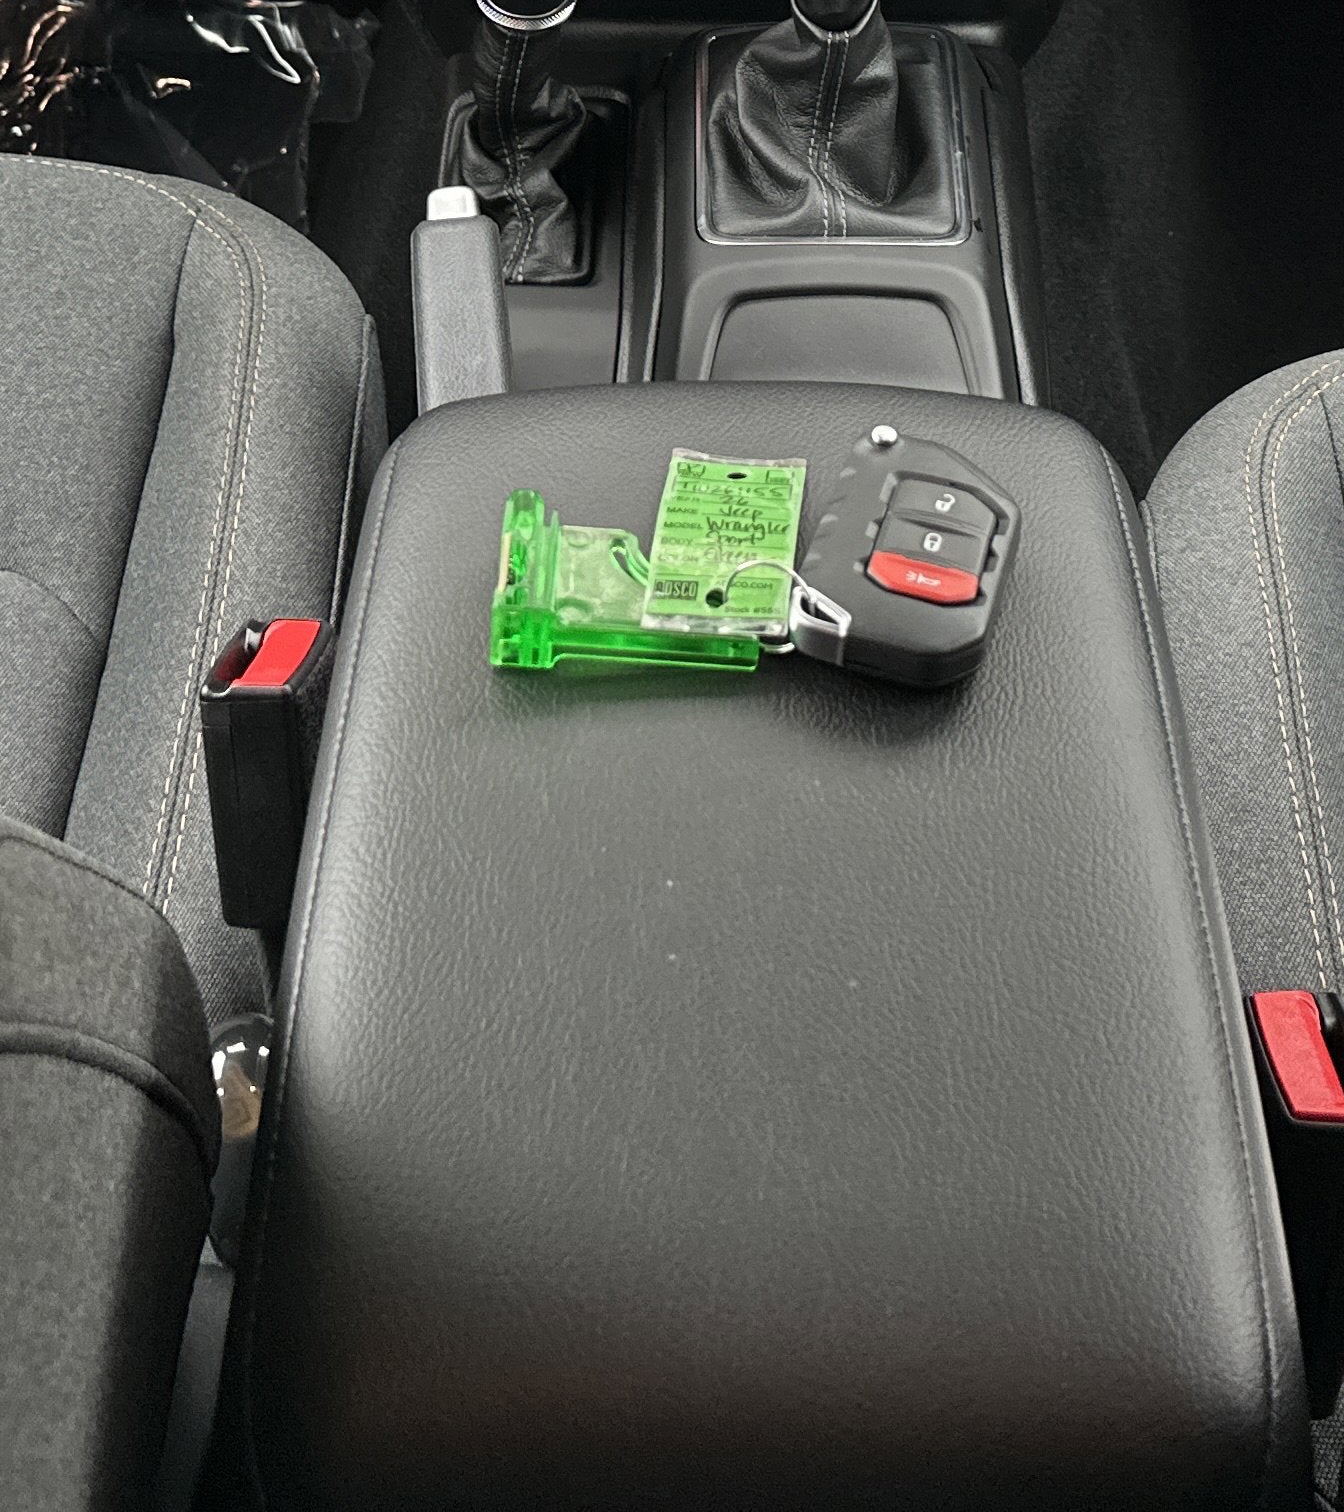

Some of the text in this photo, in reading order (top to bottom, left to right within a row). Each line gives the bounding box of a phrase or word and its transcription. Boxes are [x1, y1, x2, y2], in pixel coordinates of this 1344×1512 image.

[666, 506, 699, 514] MAKE
[720, 505, 763, 521] Jeep
[663, 521, 703, 529] MODEL
[707, 517, 791, 539] Wrangler
